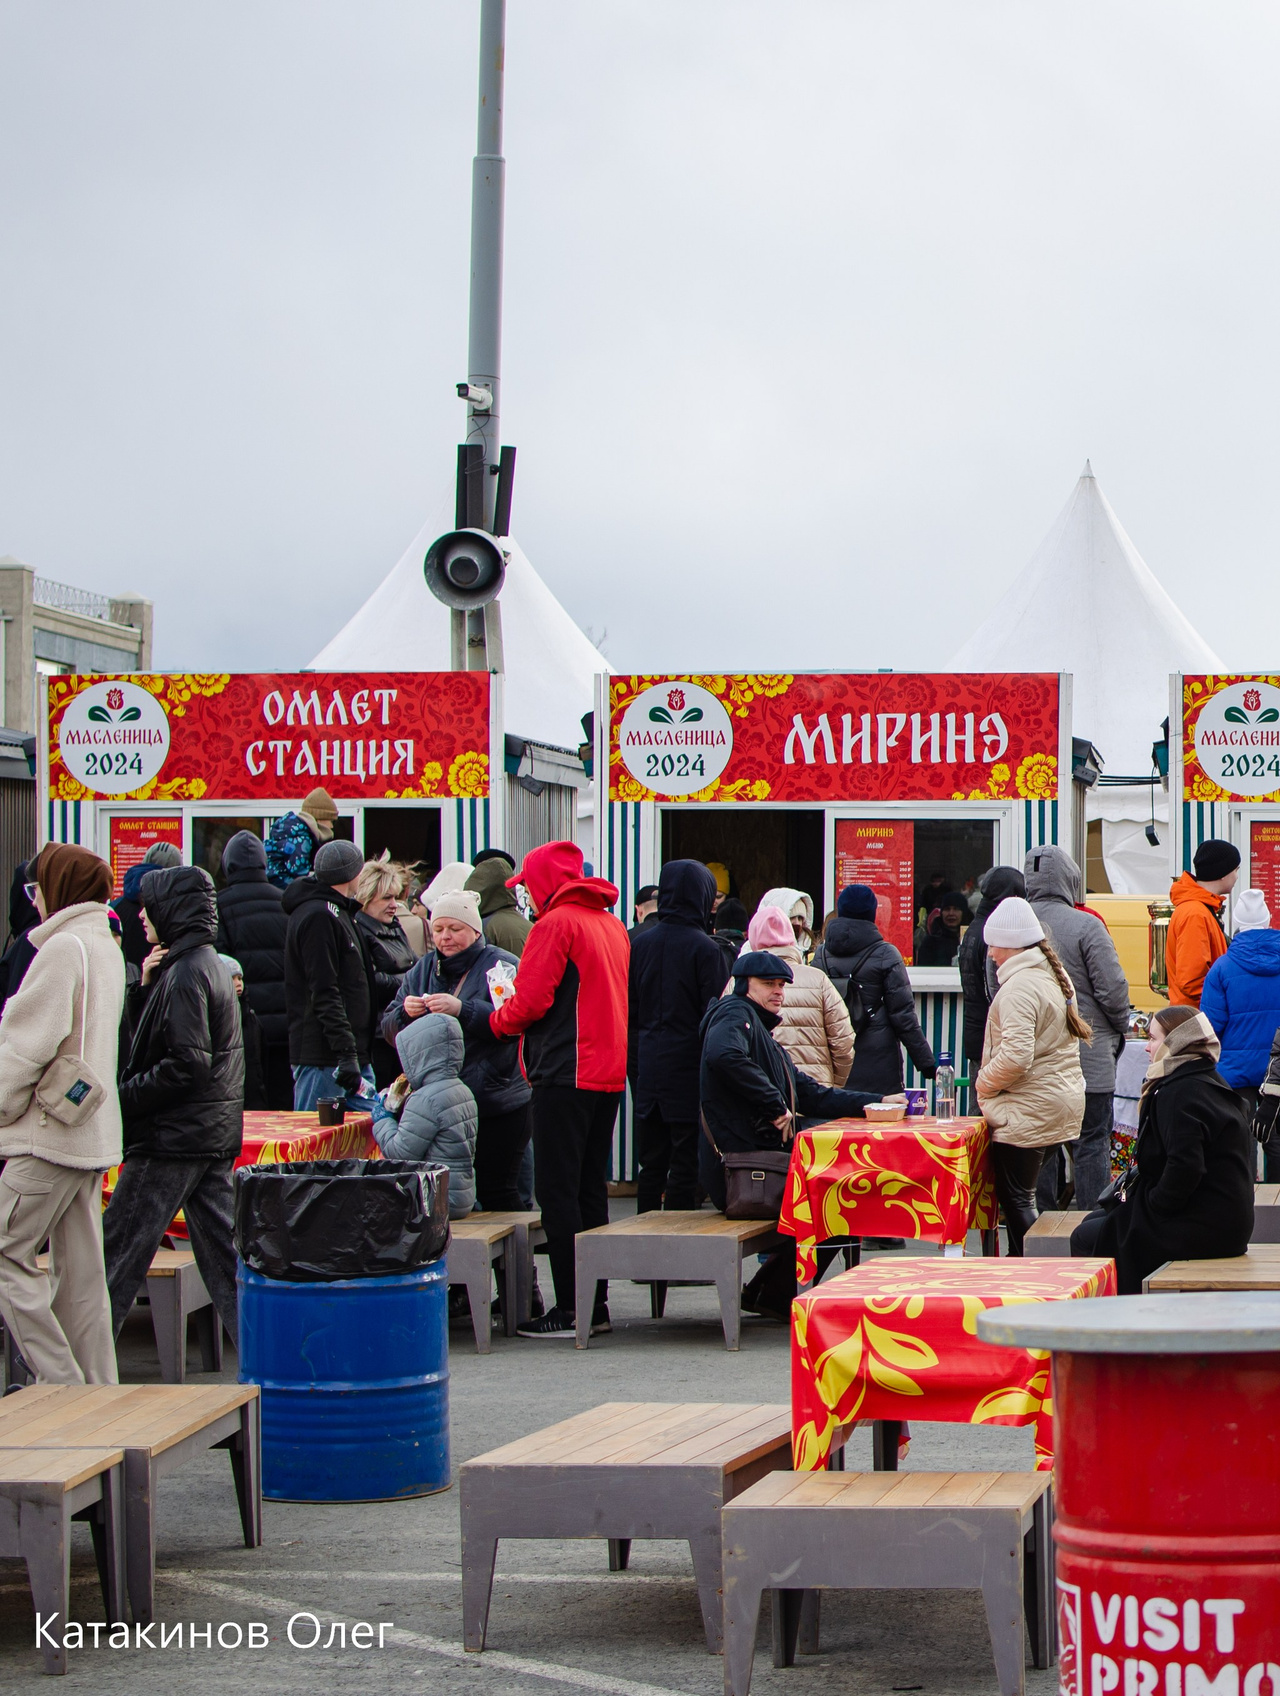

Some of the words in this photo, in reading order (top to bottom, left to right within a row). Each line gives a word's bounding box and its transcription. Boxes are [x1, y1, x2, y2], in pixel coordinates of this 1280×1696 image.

[262, 688, 398, 727] ОМЛЕТ
[65, 728, 164, 748] МАСЛЕНИЦА
[626, 729, 727, 748] МАСЛЕНИЦА
[784, 712, 1009, 765] МИРИНЭ
[84, 752, 144, 776] 2024
[245, 739, 415, 784] СТАНЦИЯ
[646, 752, 706, 777] 2024
[856, 828, 894, 837] МИРИНЭ
[1090, 1591, 1245, 1653] VISIT
